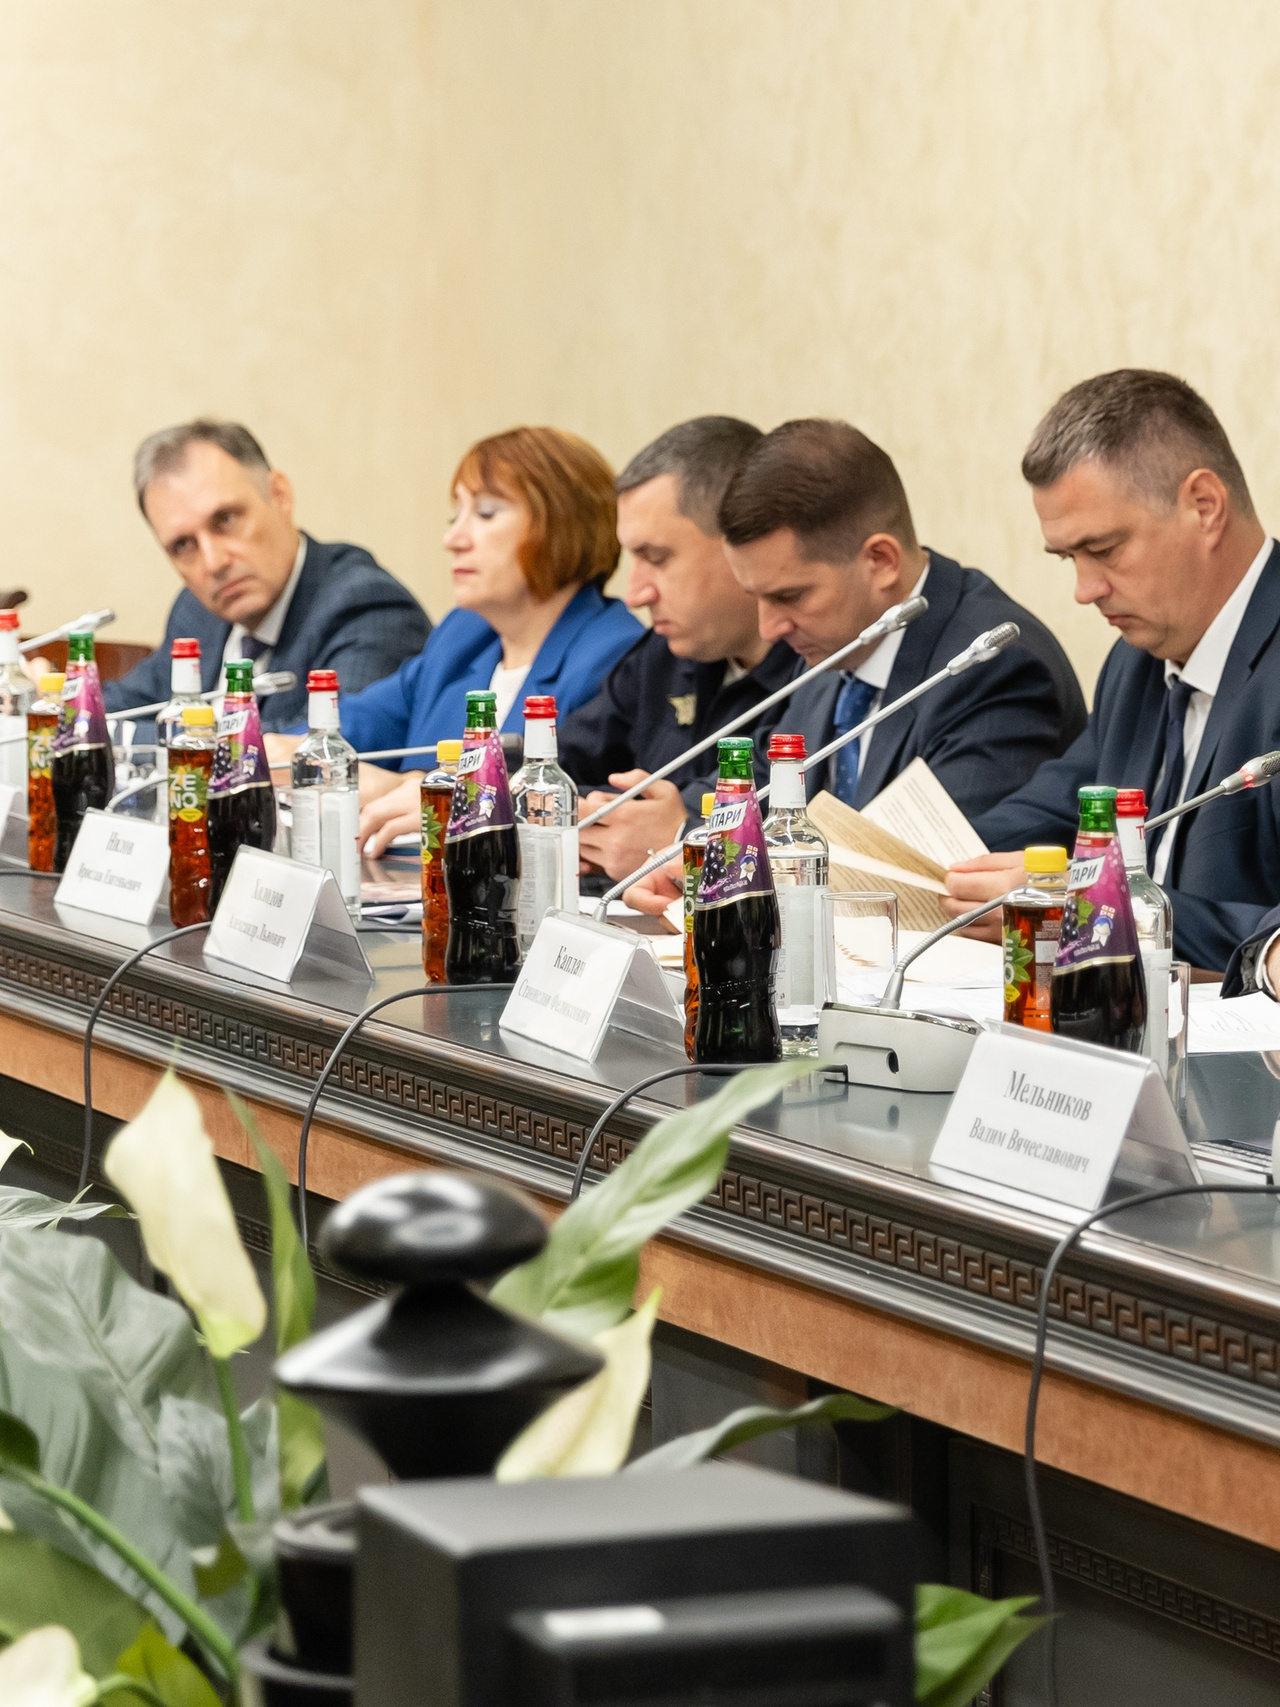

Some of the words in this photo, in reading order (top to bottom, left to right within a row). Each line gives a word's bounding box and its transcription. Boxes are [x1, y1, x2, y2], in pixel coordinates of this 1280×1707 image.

[170, 773, 196, 792] ZE
[170, 791, 198, 809] NO
[553, 945, 587, 978] Каплан
[1003, 1070, 1093, 1121] Мельников
[968, 1116, 1007, 1147] Вадим
[1006, 1128, 1091, 1173] Вячеславович
